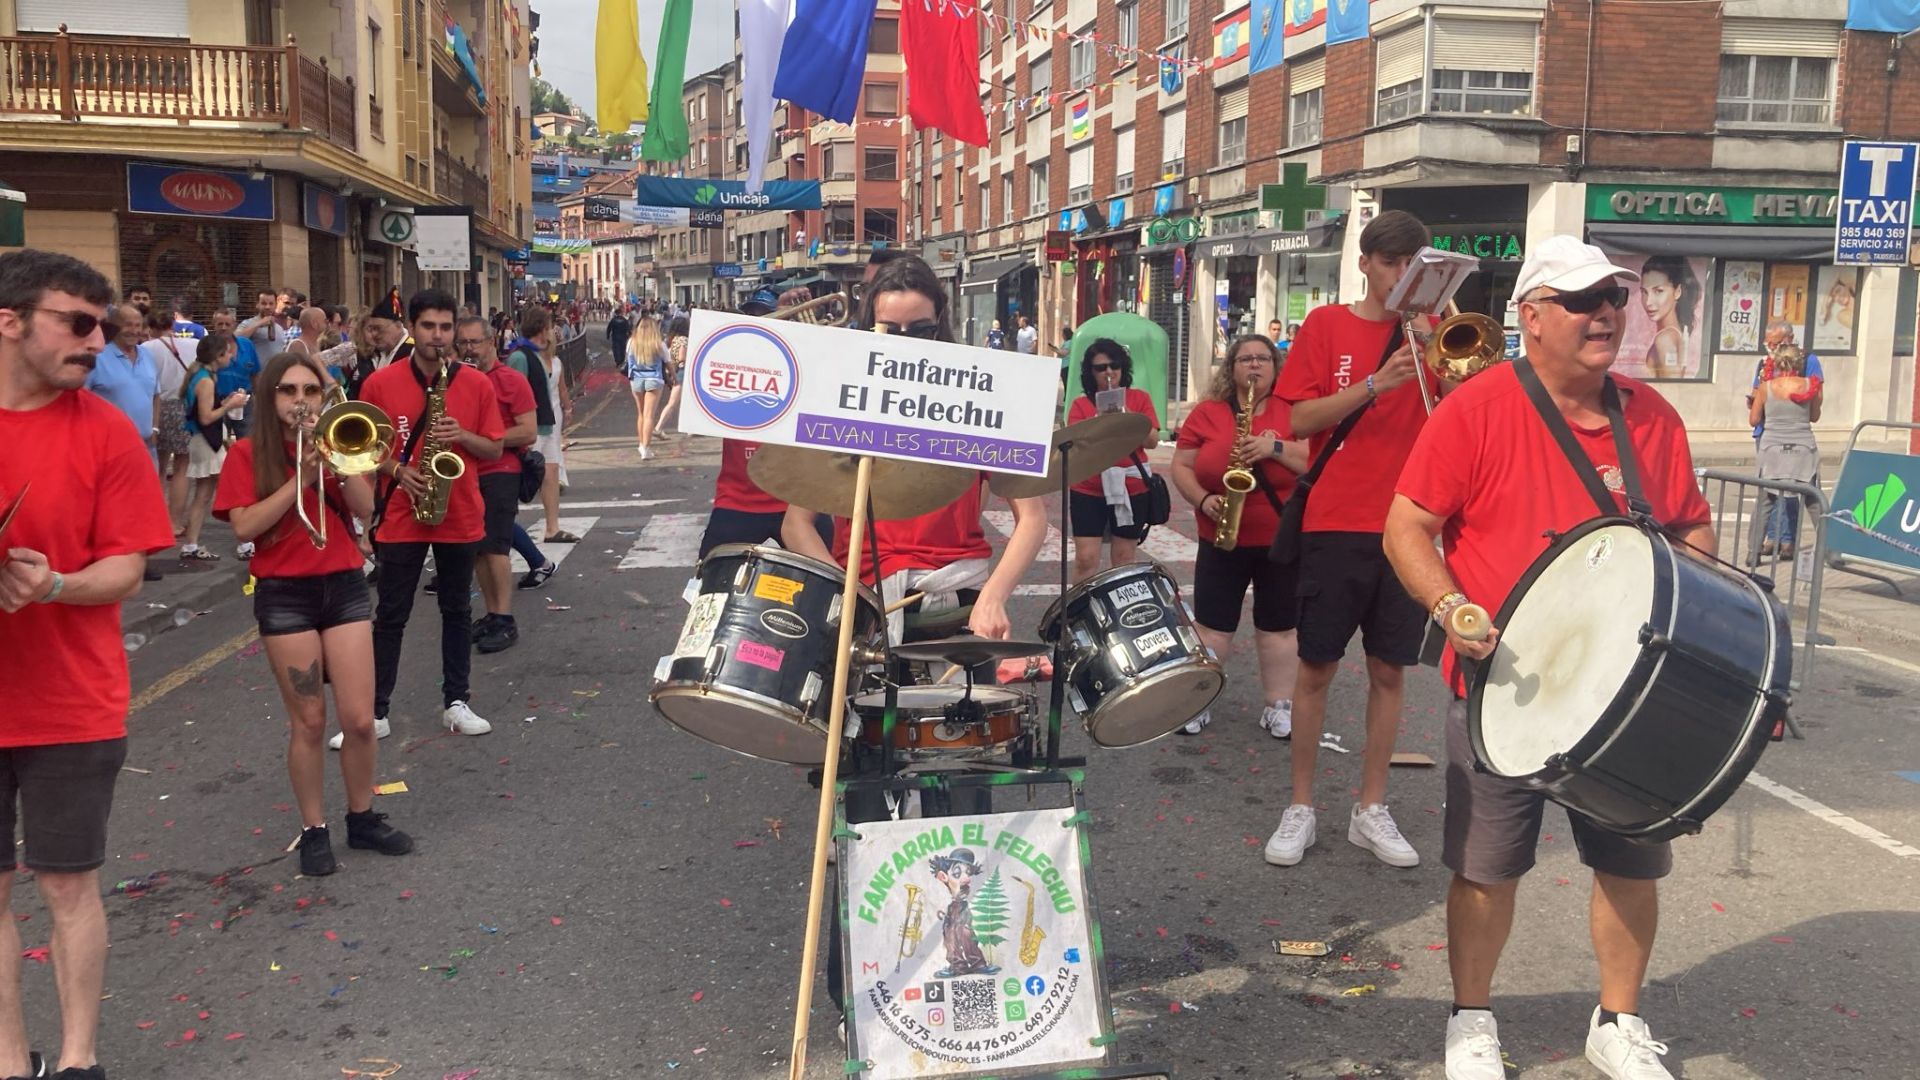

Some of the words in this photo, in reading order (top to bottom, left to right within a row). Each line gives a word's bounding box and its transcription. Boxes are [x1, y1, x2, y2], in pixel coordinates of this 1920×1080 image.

[1859, 146, 1904, 197] T
[592, 203, 619, 215] dana
[720, 191, 770, 208] Unicaja
[1610, 190, 1728, 216] OPTICA
[697, 211, 723, 222] dana
[1843, 199, 1907, 224] TAXI
[1271, 235, 1310, 252] FARMACIA
[1840, 239, 1881, 249] SERVICIO
[1883, 240, 1893, 249] 24
[1841, 227, 1861, 238] 985
[1863, 227, 1883, 238] 840
[1886, 228, 1905, 238] 369
[1212, 243, 1234, 256] OPTICA
[1433, 235, 1522, 258] MACIA
[1729, 311, 1751, 325] GH
[709, 361, 736, 370] DESCENSO
[735, 365, 772, 376] INTERNACIONAL
[867, 351, 995, 392] Fanfarria
[1334, 354, 1352, 392] chu
[709, 369, 780, 395] SELLA
[838, 383, 869, 411] El
[880, 389, 1004, 429] Felechu
[805, 423, 875, 446] VIVAN
[883, 433, 920, 451] LES
[927, 438, 1037, 466] PIRAGUES
[1135, 631, 1169, 652] Corvera
[857, 825, 957, 924] FANFARRIA
[962, 823, 988, 847] EL
[993, 830, 1077, 914] FELECHU
[876, 980, 893, 1004] 646
[889, 1003, 903, 1017] 16
[900, 1015, 916, 1030] 65
[915, 1025, 931, 1040] 75
[938, 1037, 963, 1052] 666
[965, 1041, 981, 1052] 44
[983, 1038, 999, 1050] 76
[1000, 1031, 1017, 1045] 90
[1025, 1012, 1044, 1032] 649
[1041, 998, 1055, 1014] 37
[1050, 982, 1065, 999] 92
[1058, 967, 1070, 980] 12
